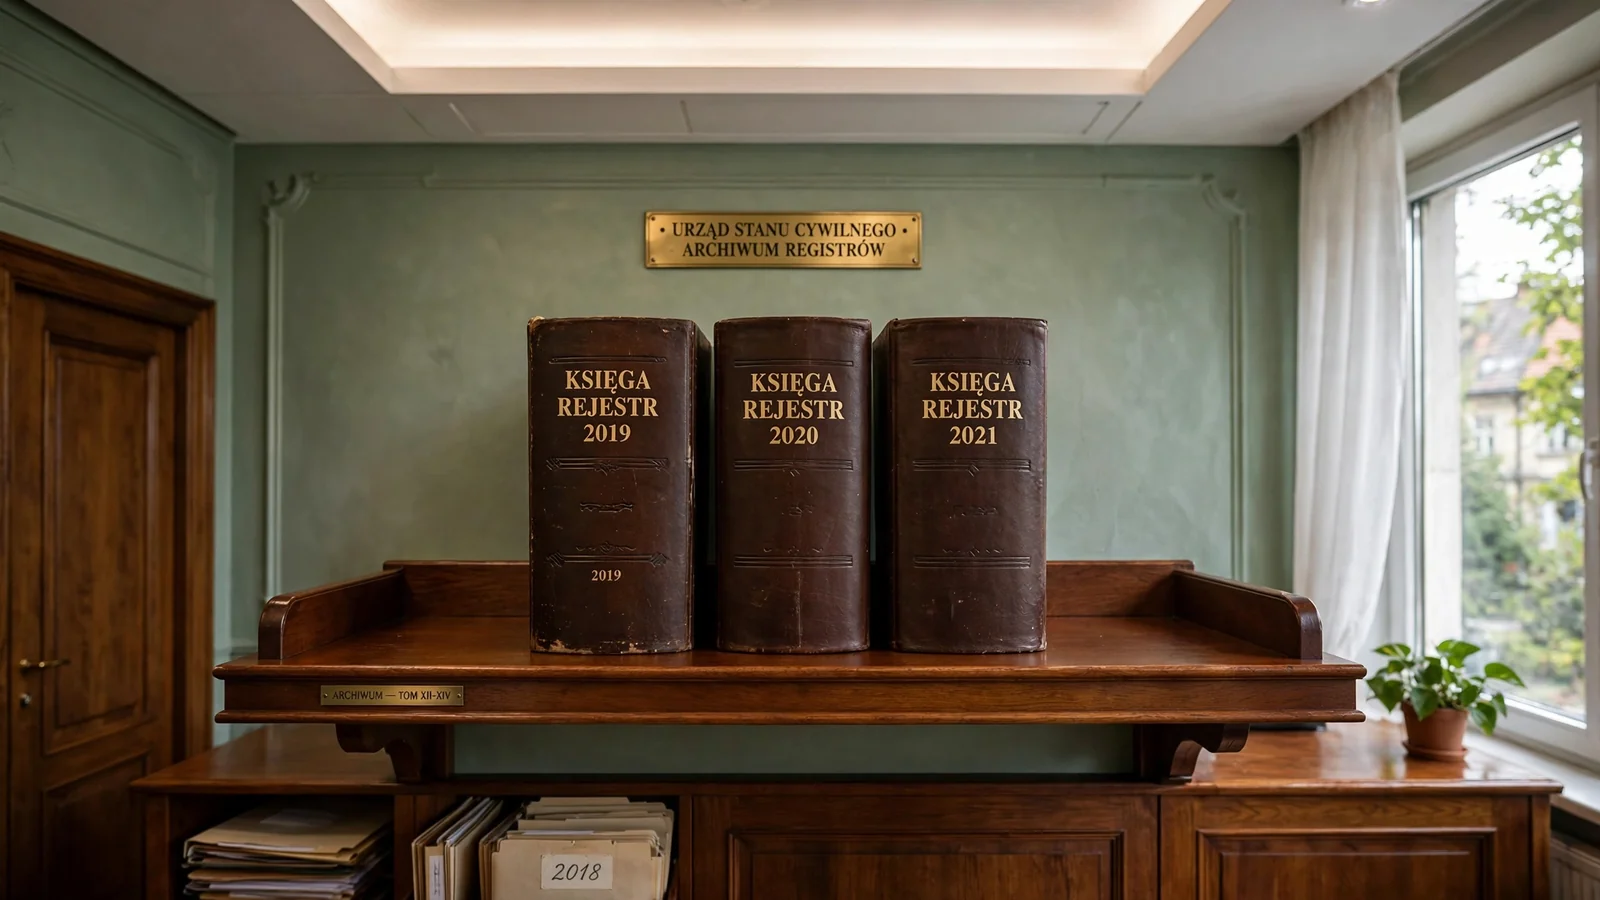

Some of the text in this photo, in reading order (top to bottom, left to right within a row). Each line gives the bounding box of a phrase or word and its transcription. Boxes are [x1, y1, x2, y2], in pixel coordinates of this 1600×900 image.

[672, 222, 897, 240] URZĄD STANU CYWILNEGO
[682, 239, 886, 257] ARCHIWUM REGISTRÓW
[565, 369, 651, 394] KSIĘGA
[750, 372, 838, 397] KSIĘGA
[930, 371, 1016, 396] KSIĘGA
[557, 396, 659, 417] REJESTR
[743, 399, 845, 420] REJESTR
[922, 398, 1024, 420] REJESTR
[583, 423, 631, 443] 2019
[769, 426, 819, 445] 2020
[949, 425, 998, 445] 2021
[591, 569, 622, 582] 2019
[331, 690, 383, 700] ARCHIWUM
[398, 690, 418, 700] TOM
[420, 690, 451, 700] XII-XIV
[551, 863, 602, 881] 2018
